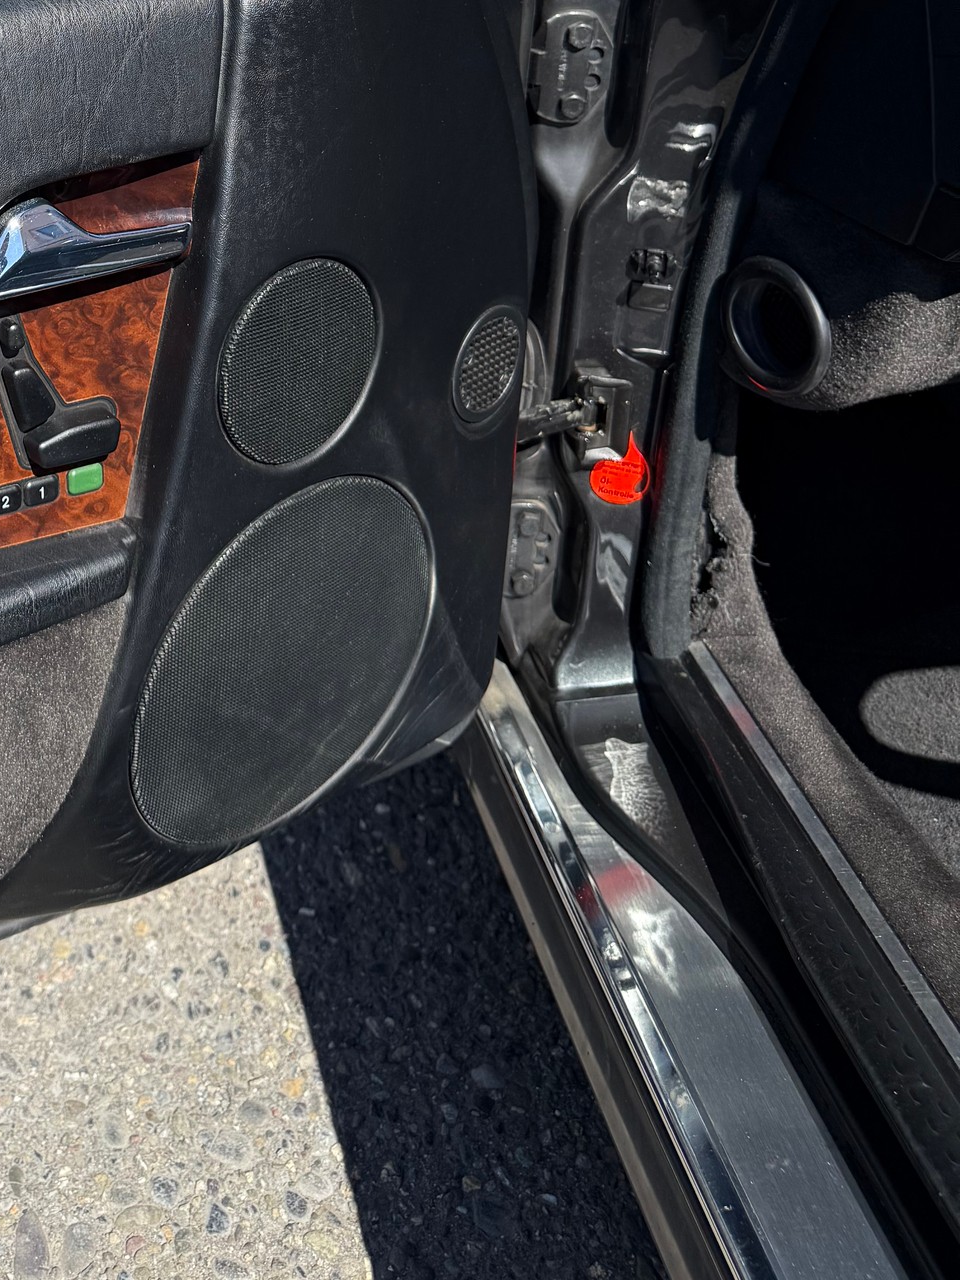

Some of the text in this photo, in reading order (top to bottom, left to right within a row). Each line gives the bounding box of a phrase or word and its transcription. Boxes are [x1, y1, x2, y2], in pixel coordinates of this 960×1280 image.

[1, 496, 10, 509] 2
[39, 486, 45, 499] 1
[598, 486, 634, 499] Kontrolle
